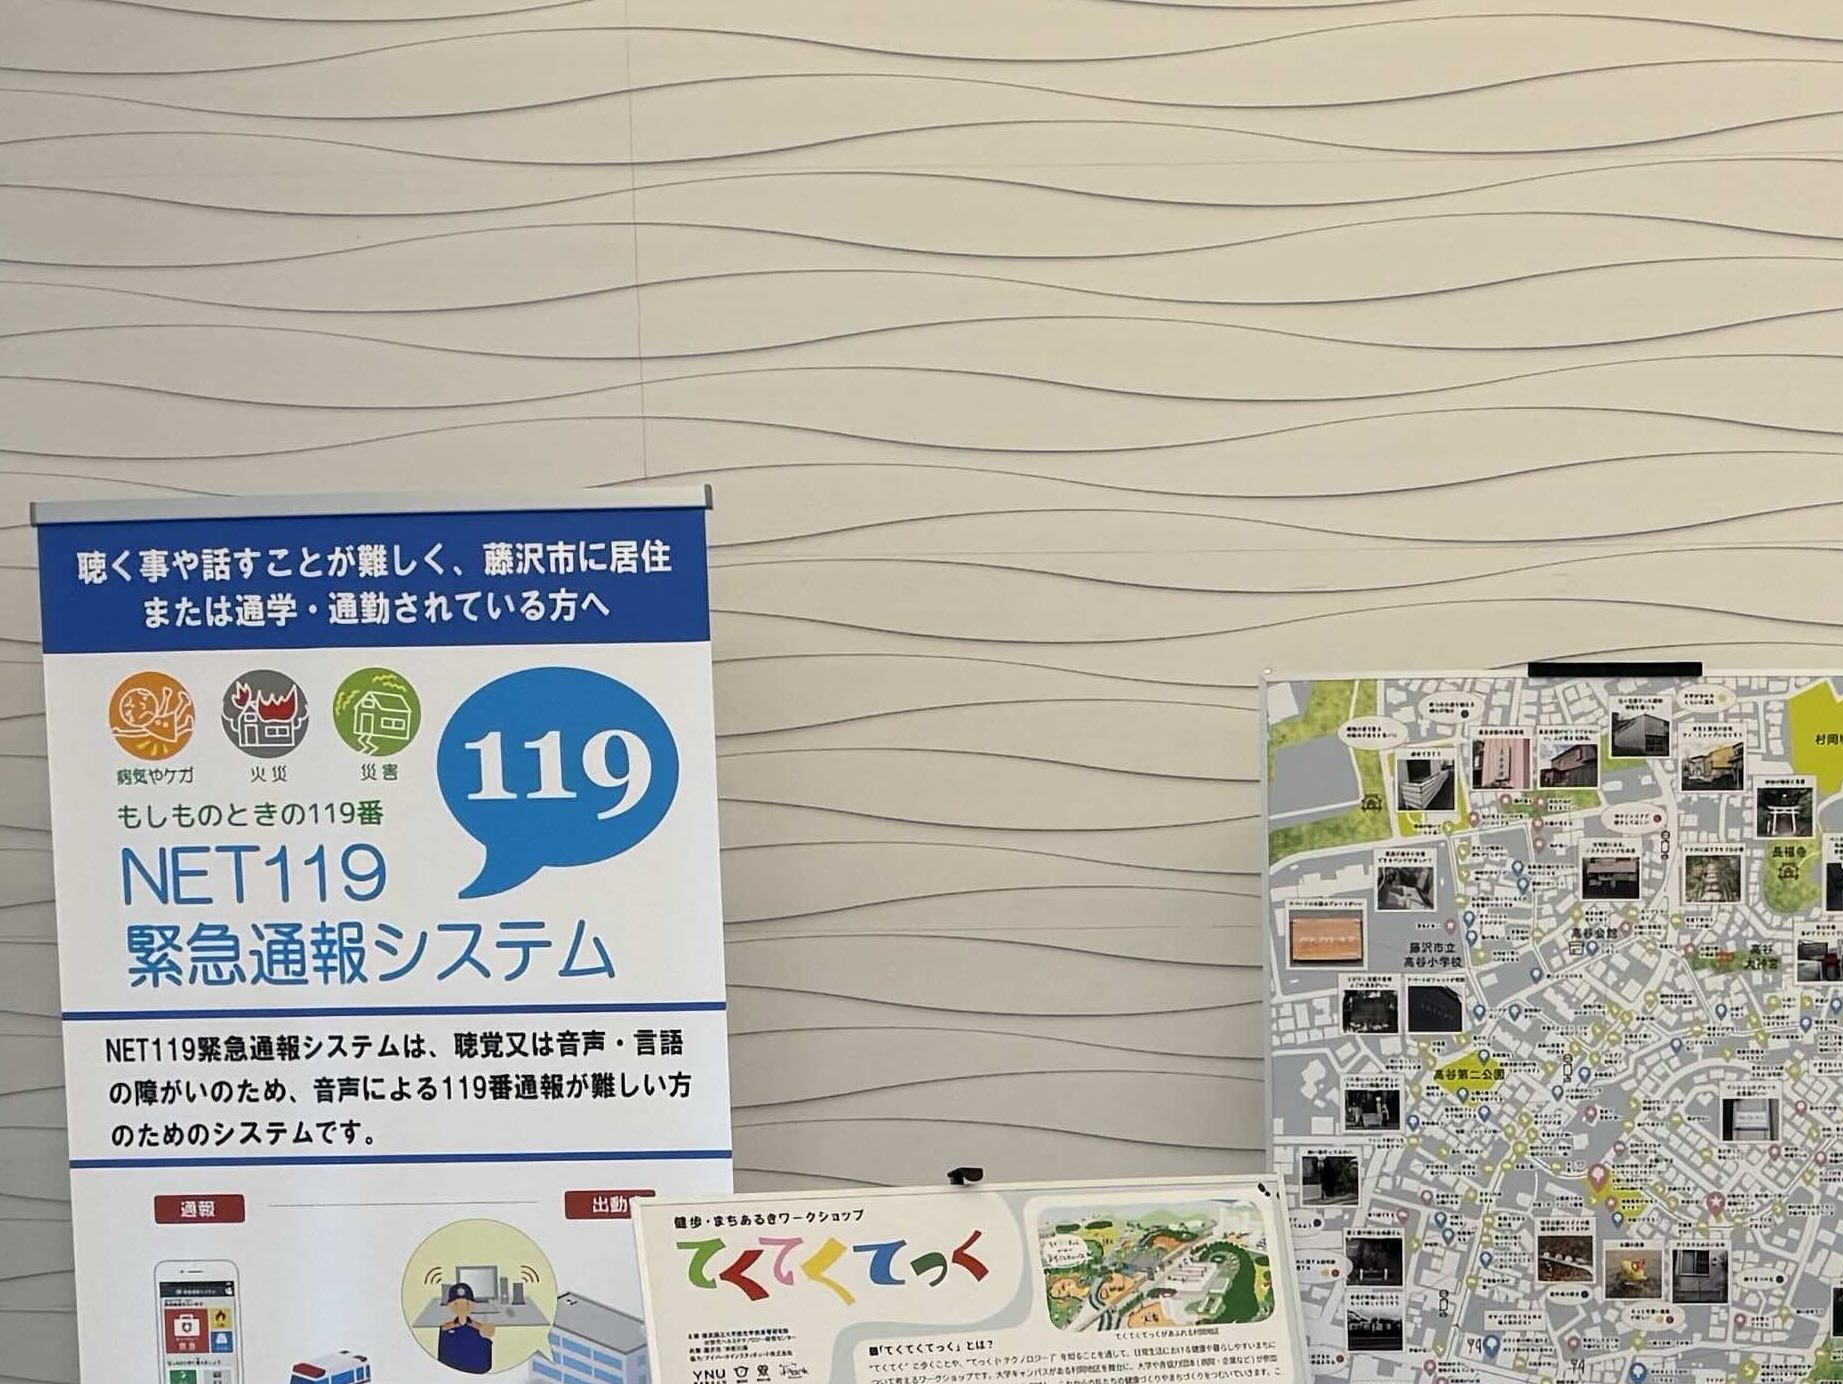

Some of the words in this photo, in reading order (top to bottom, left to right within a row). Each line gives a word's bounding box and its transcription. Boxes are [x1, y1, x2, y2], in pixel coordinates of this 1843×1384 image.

[77, 539, 672, 585] 聴く事や話すことが難しく、藤沢市に居住
[144, 590, 610, 629] または通学・通勤されている方へ
[116, 764, 195, 787] 病気やケガ
[250, 763, 289, 783] 火災
[361, 761, 399, 782] 災害
[465, 730, 651, 821] 119
[117, 799, 385, 830] もしものときの119番
[120, 843, 387, 906] NET119
[127, 918, 616, 989] 緊急通報システム
[105, 1028, 684, 1064] NET119緊急通報システムは、聴覚又は音声・言語
[109, 1072, 692, 1106] の障がいのため、音声による119番通報が難しい方
[112, 1119, 376, 1149] のためのシステムです。
[179, 1200, 216, 1220] 通報
[675, 1229, 990, 1307] てくてくてっく
[692, 1368, 727, 1381] YNU
